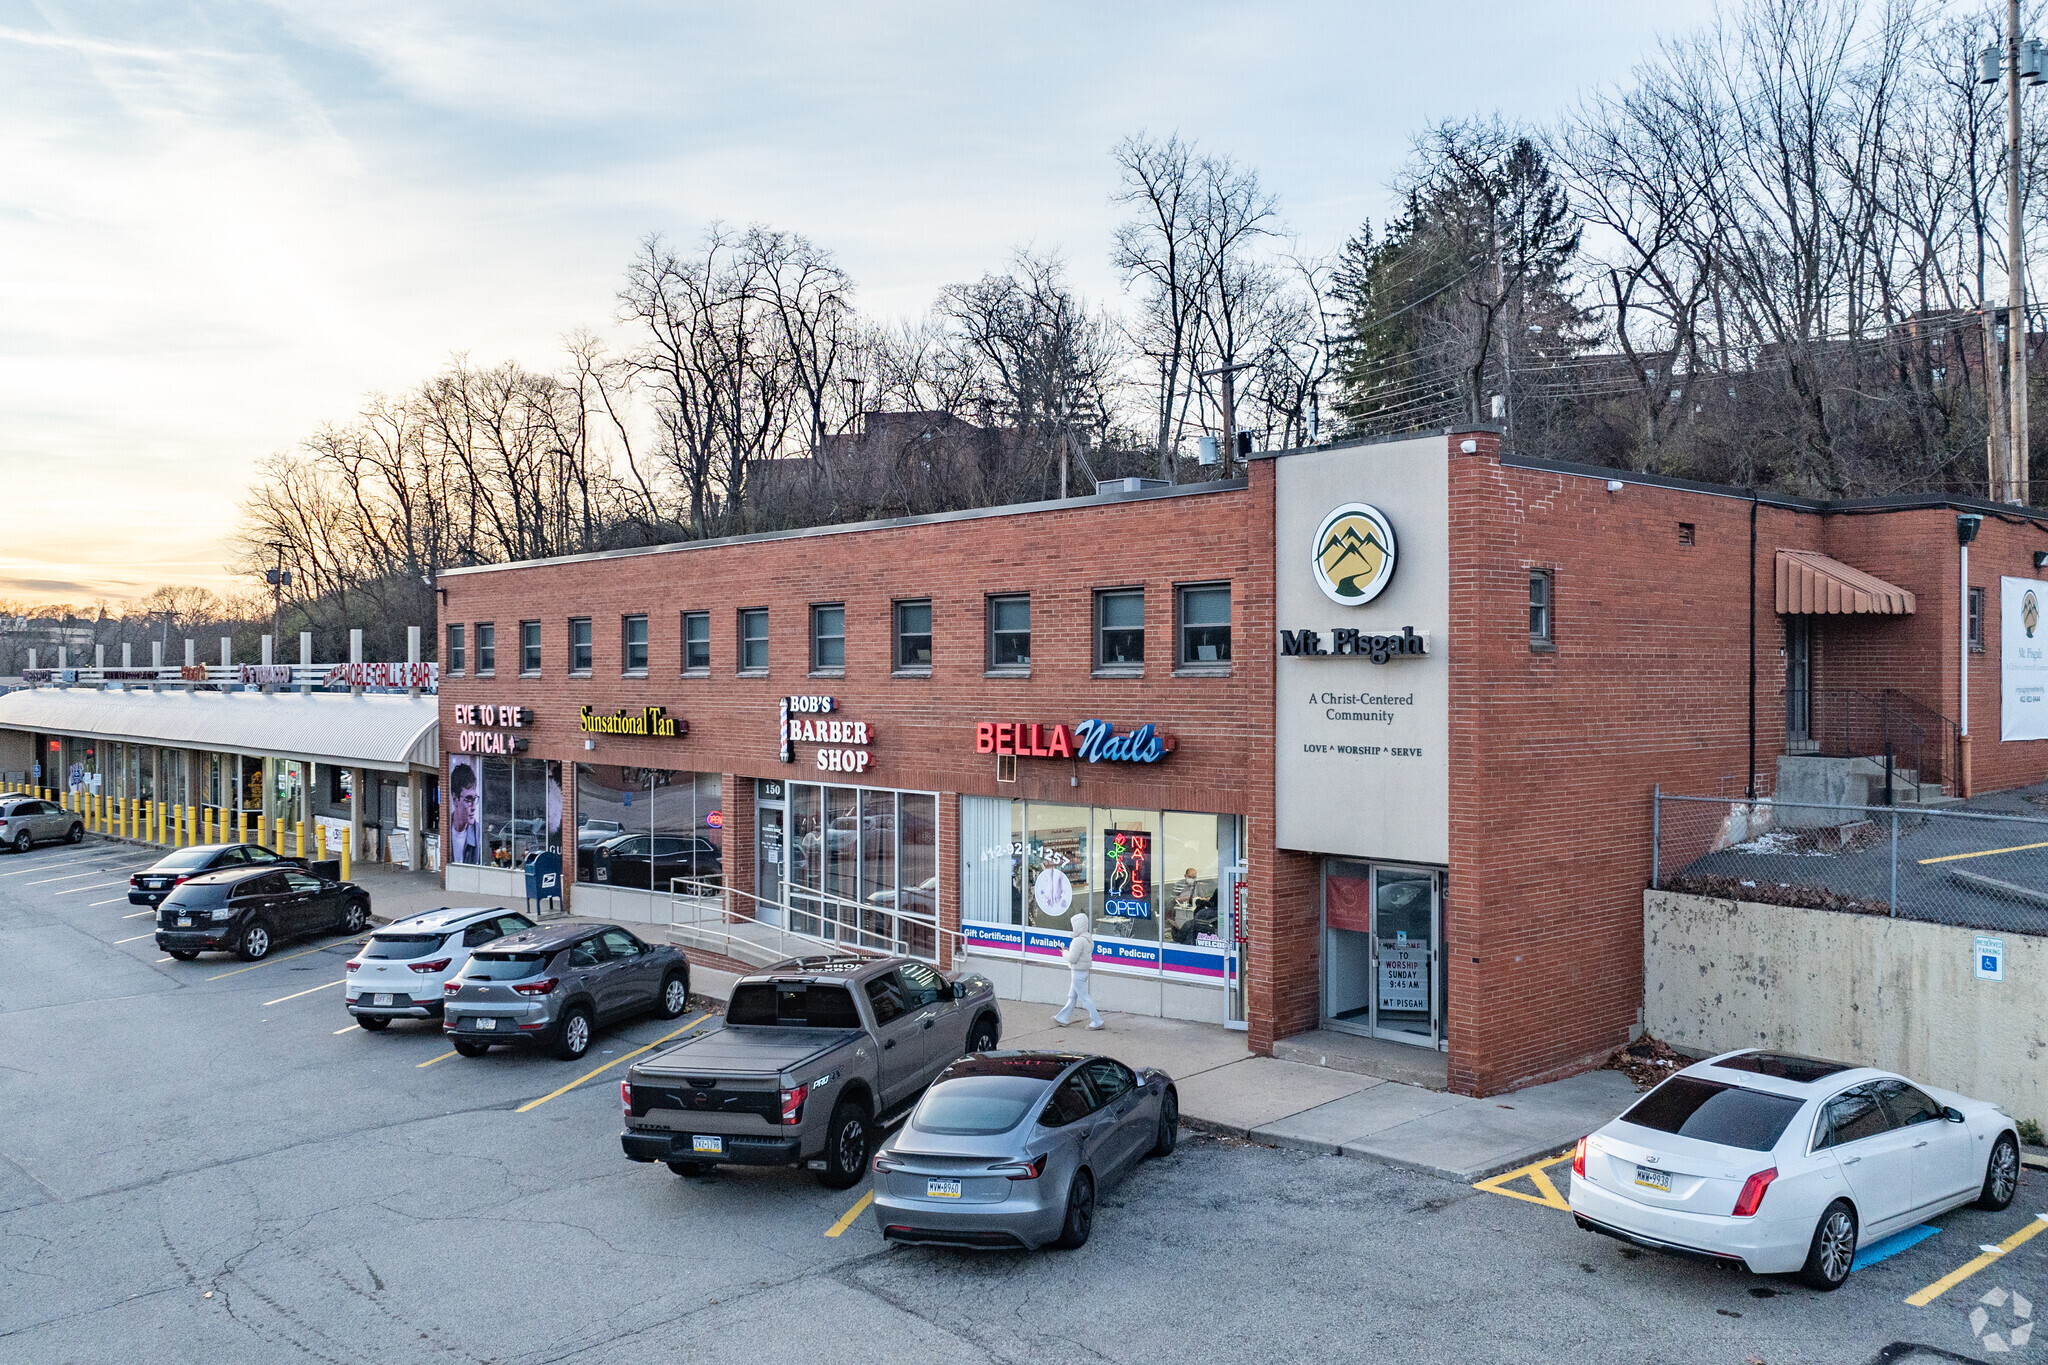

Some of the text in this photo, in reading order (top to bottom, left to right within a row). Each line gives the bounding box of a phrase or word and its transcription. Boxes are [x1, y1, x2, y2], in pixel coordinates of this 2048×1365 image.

[1280, 626, 1425, 665] Mt. Pisgah
[345, 663, 371, 686] NOBLE
[374, 663, 398, 686] GRILL
[401, 663, 407, 686] &
[411, 663, 430, 686] BAR
[790, 695, 831, 713] BOB'S
[1309, 692, 1414, 705] A Christ-Centered
[455, 704, 522, 728] EYE TO EYE
[580, 705, 675, 736] Sunsational Tan
[1326, 708, 1394, 725] Community
[790, 719, 868, 745] BARBER
[459, 731, 507, 754] OPTICAL
[976, 719, 1161, 764] BELLA Nails
[1303, 744, 1327, 753] LOVE
[1337, 745, 1381, 755] WORSHIP
[1391, 747, 1422, 757] SERVE
[817, 749, 869, 773] SHOP
[765, 784, 781, 795] 150
[1131, 834, 1145, 899] NAILS
[1105, 900, 1148, 917] OPEN
[964, 928, 1156, 960] Gift Certificates Available Spa Pedicure
[1978, 947, 2001, 956] PARKING
[1399, 952, 1409, 960] TO
[1386, 961, 1418, 970] WORSHIP
[1388, 971, 1417, 979] SUNDAY
[1409, 981, 1420, 989] AM
[1383, 999, 1423, 1008] MT PISGAH
